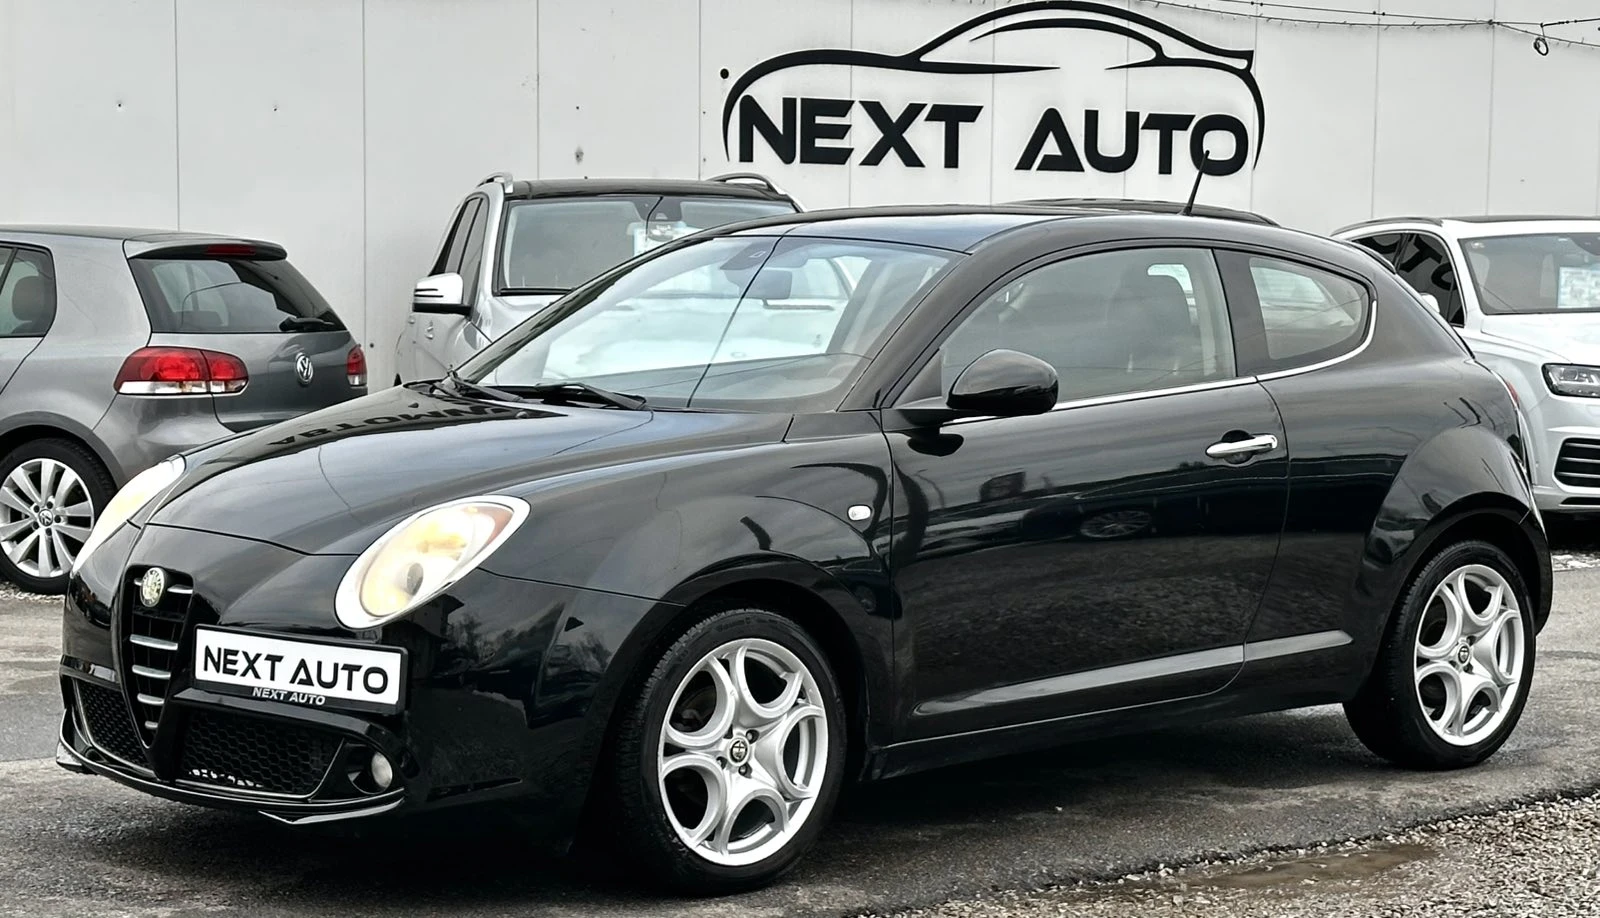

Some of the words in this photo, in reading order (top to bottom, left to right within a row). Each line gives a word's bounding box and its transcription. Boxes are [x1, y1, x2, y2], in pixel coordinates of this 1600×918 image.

[739, 95, 983, 168] NEXT
[1015, 108, 1249, 177] AUTO
[203, 645, 284, 681] NEXT
[289, 659, 388, 694] AUTO
[252, 687, 288, 700] NEXT
[289, 692, 326, 705] AUTO
